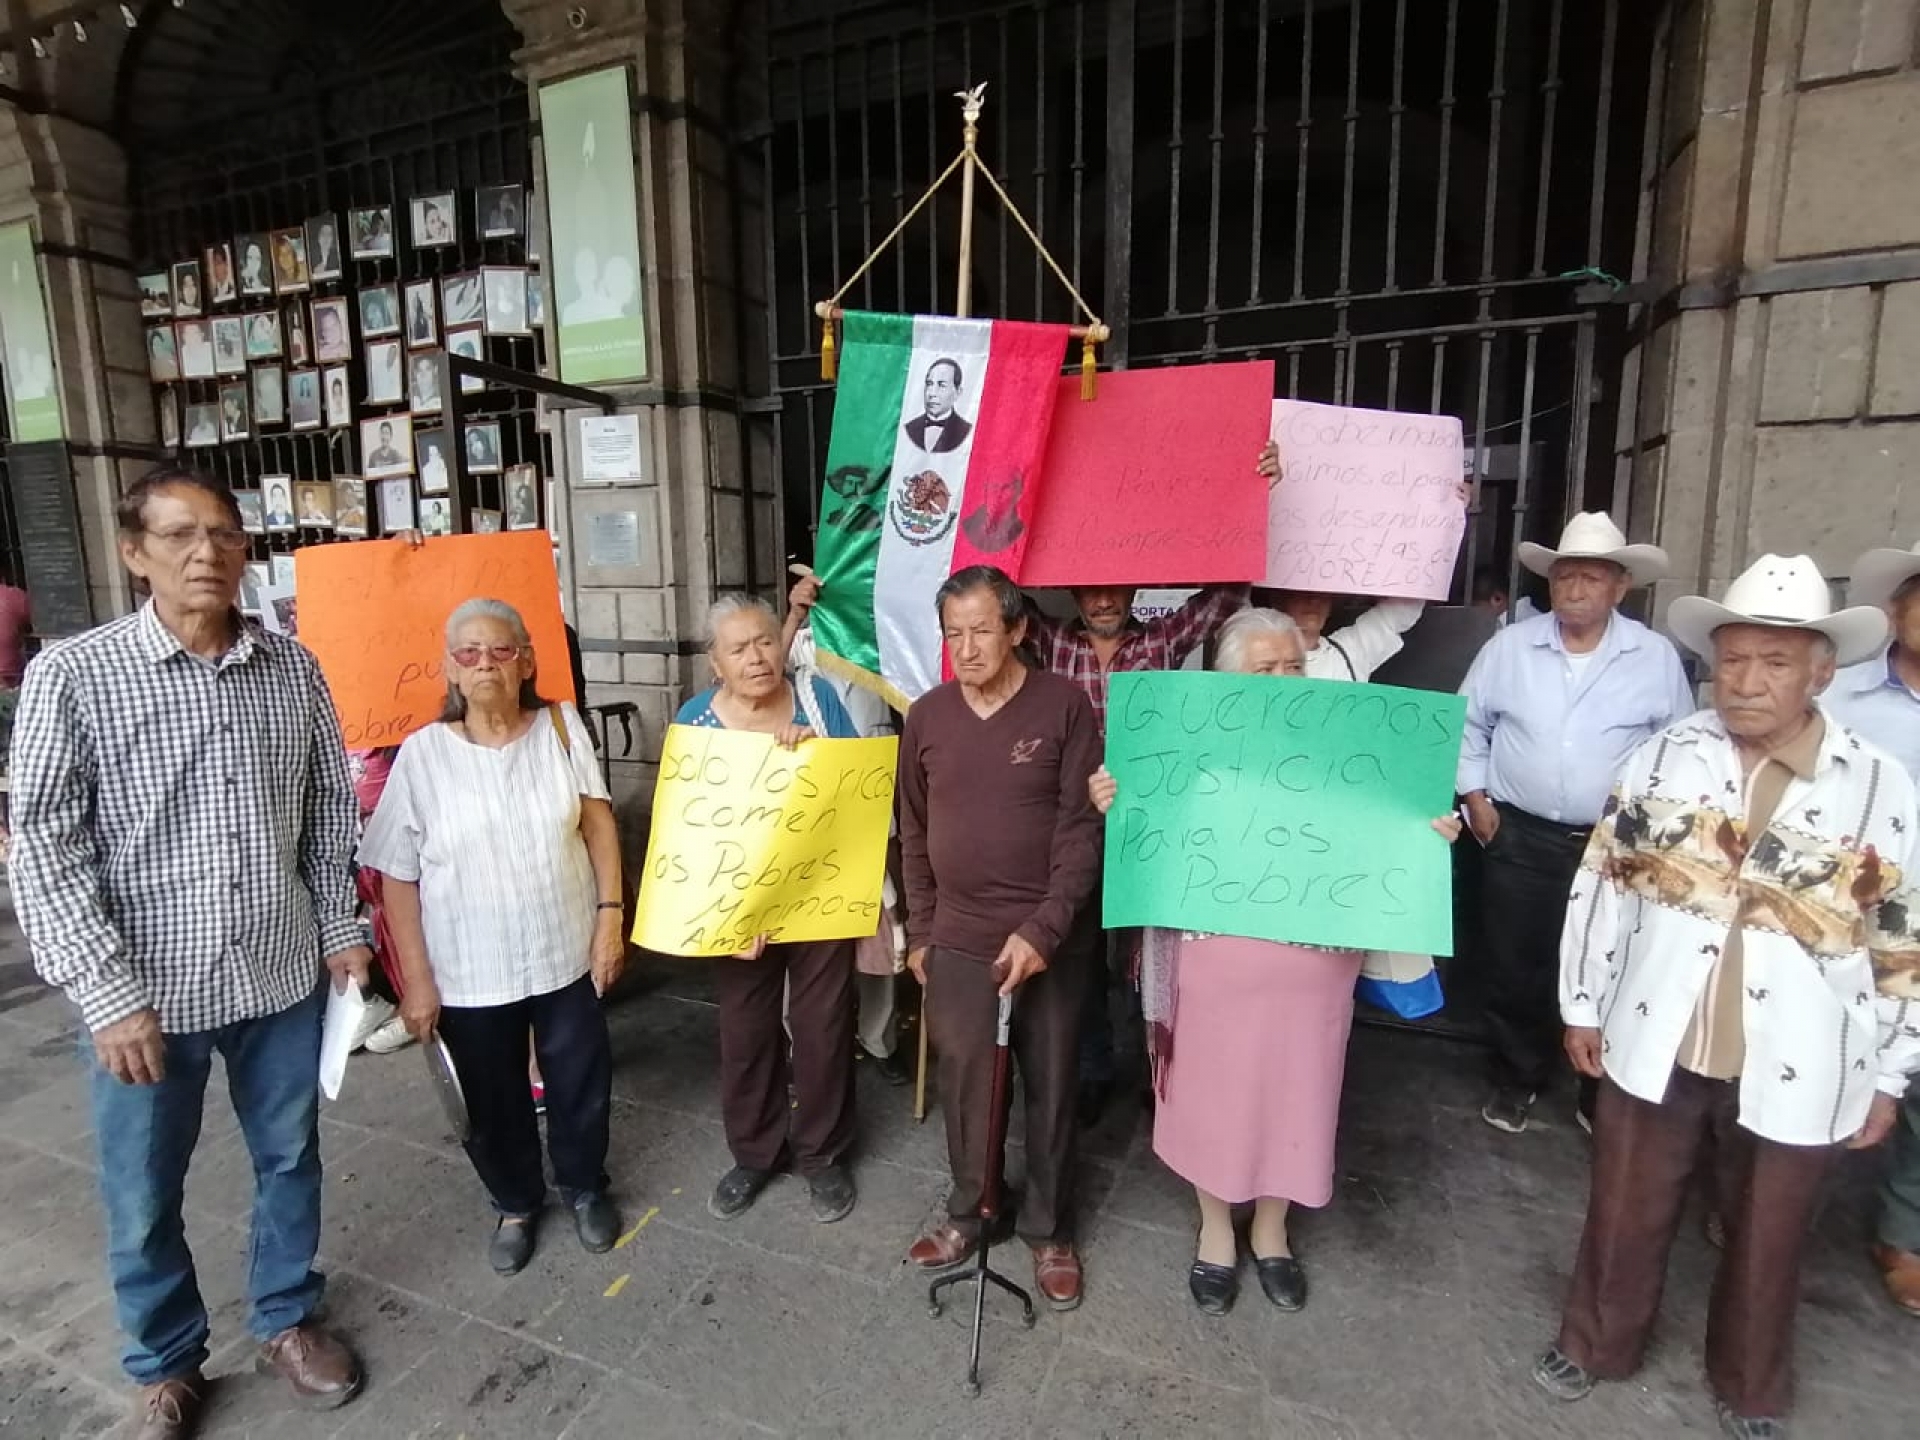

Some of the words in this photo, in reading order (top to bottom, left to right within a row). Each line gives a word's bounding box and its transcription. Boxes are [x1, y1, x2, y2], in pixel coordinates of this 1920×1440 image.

[1130, 606, 1175, 617] PORTA
[394, 661, 441, 701] pu
[1124, 677, 1452, 746] Queremos
[750, 745, 819, 799] los
[1127, 735, 1388, 798] Justicia
[1240, 806, 1331, 853] los
[708, 840, 842, 890] Pobres
[1180, 853, 1411, 916] Pobres
